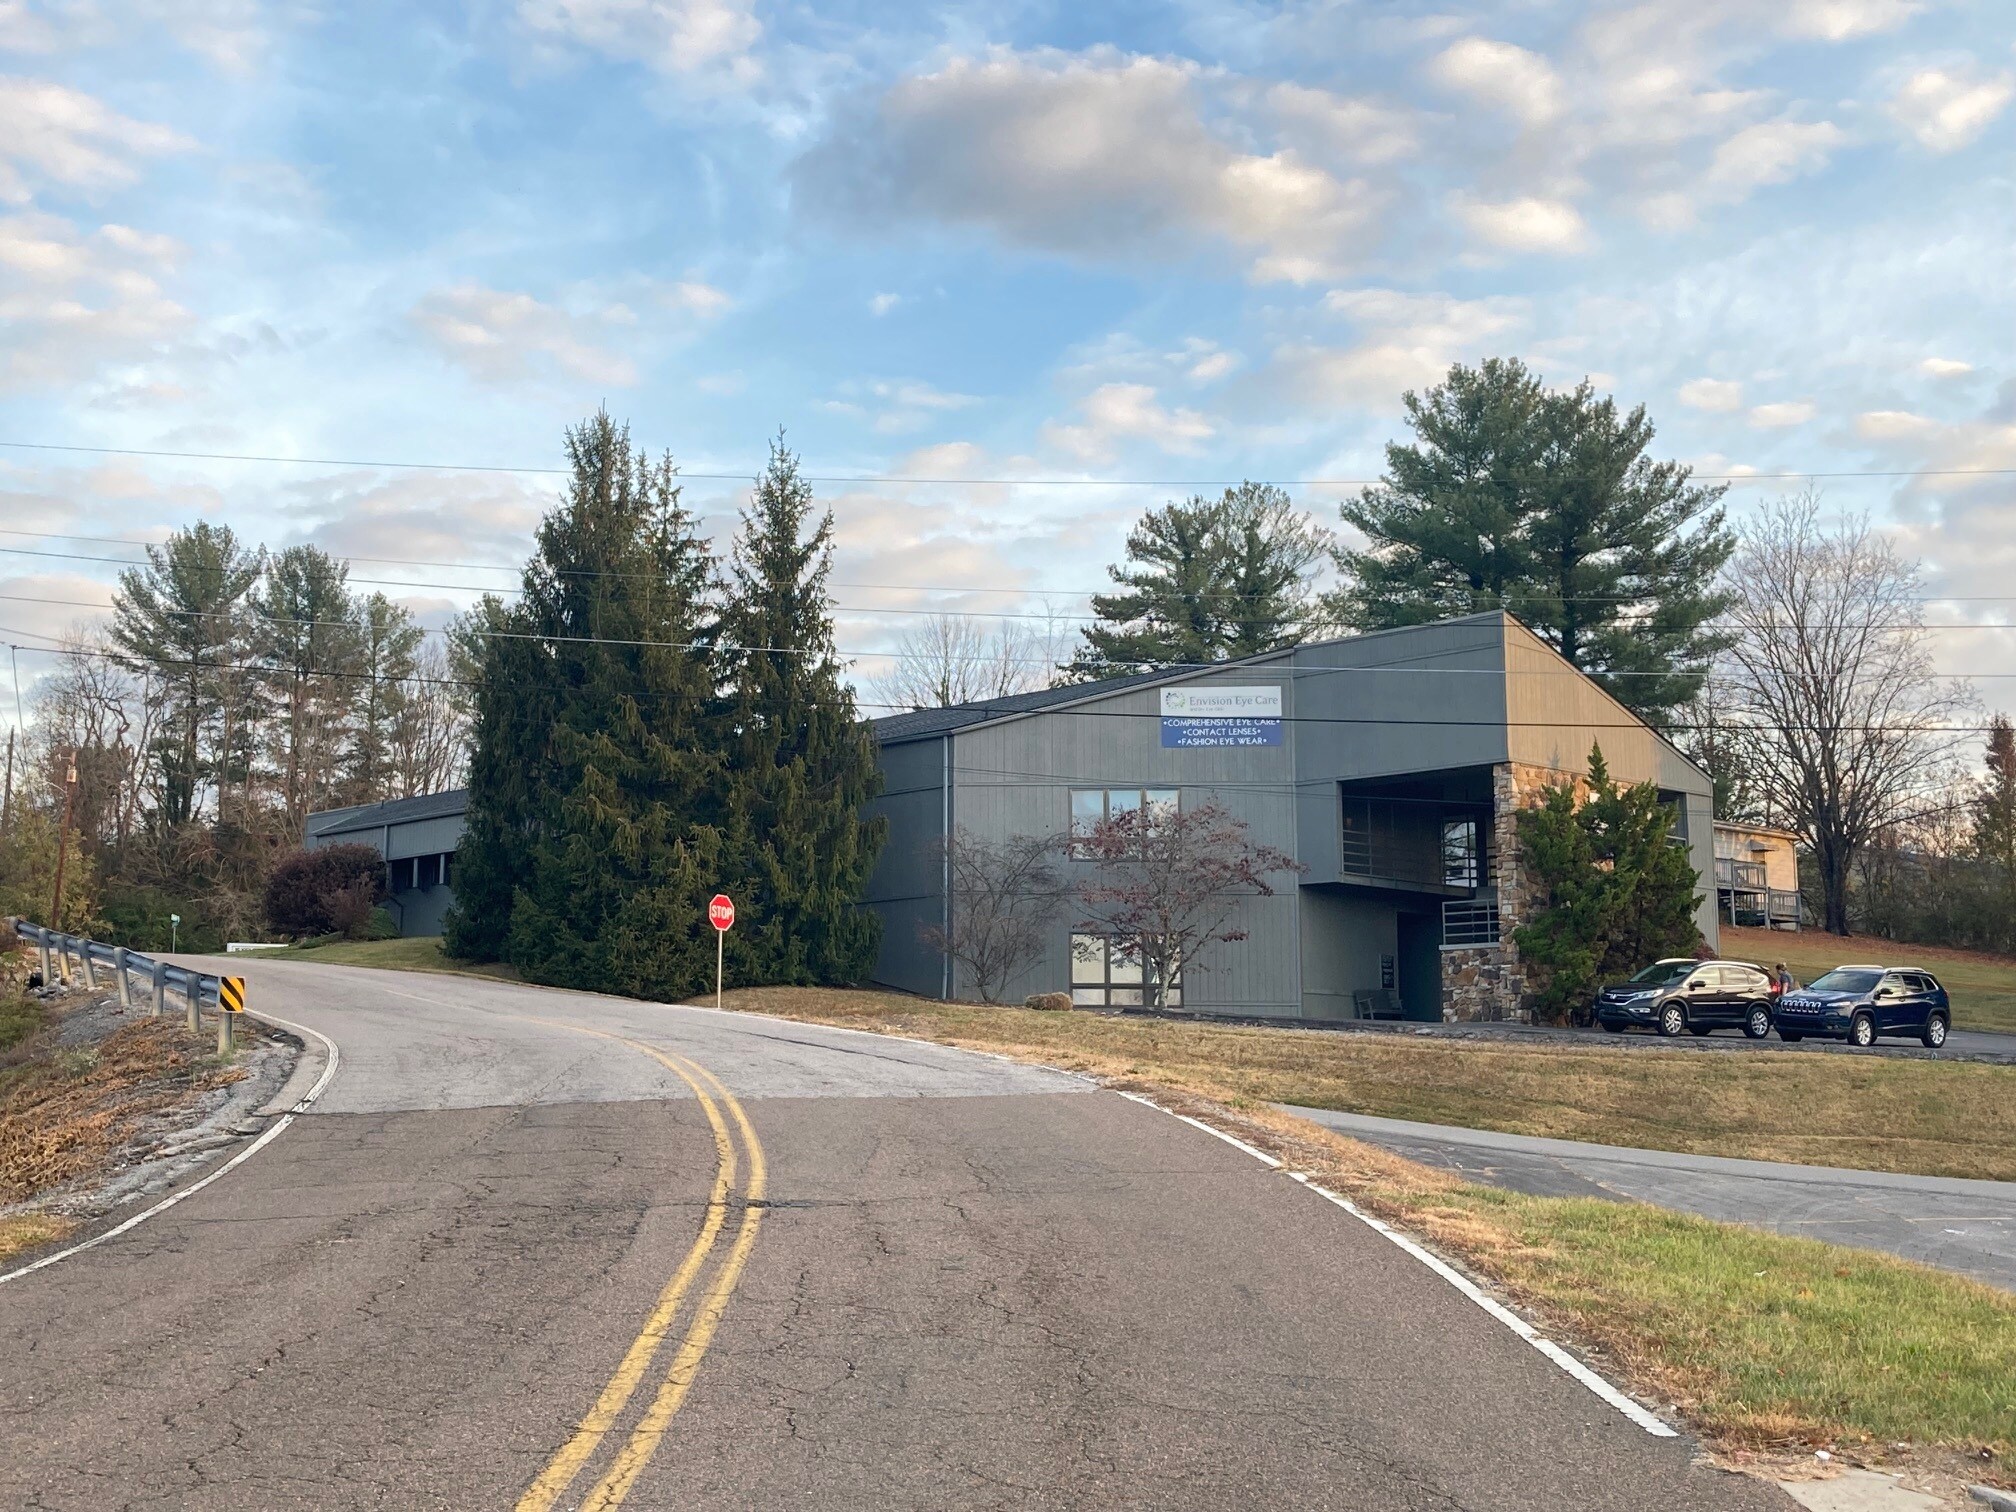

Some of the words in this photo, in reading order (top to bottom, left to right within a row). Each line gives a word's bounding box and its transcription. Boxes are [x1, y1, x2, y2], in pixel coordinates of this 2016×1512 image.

[1189, 696, 1232, 706] Envision
[1235, 696, 1253, 707] Eye
[1255, 696, 1278, 705] Care
[1236, 718, 1252, 726] EYE
[1219, 737, 1235, 745] EYE
[711, 905, 732, 920] STOP
